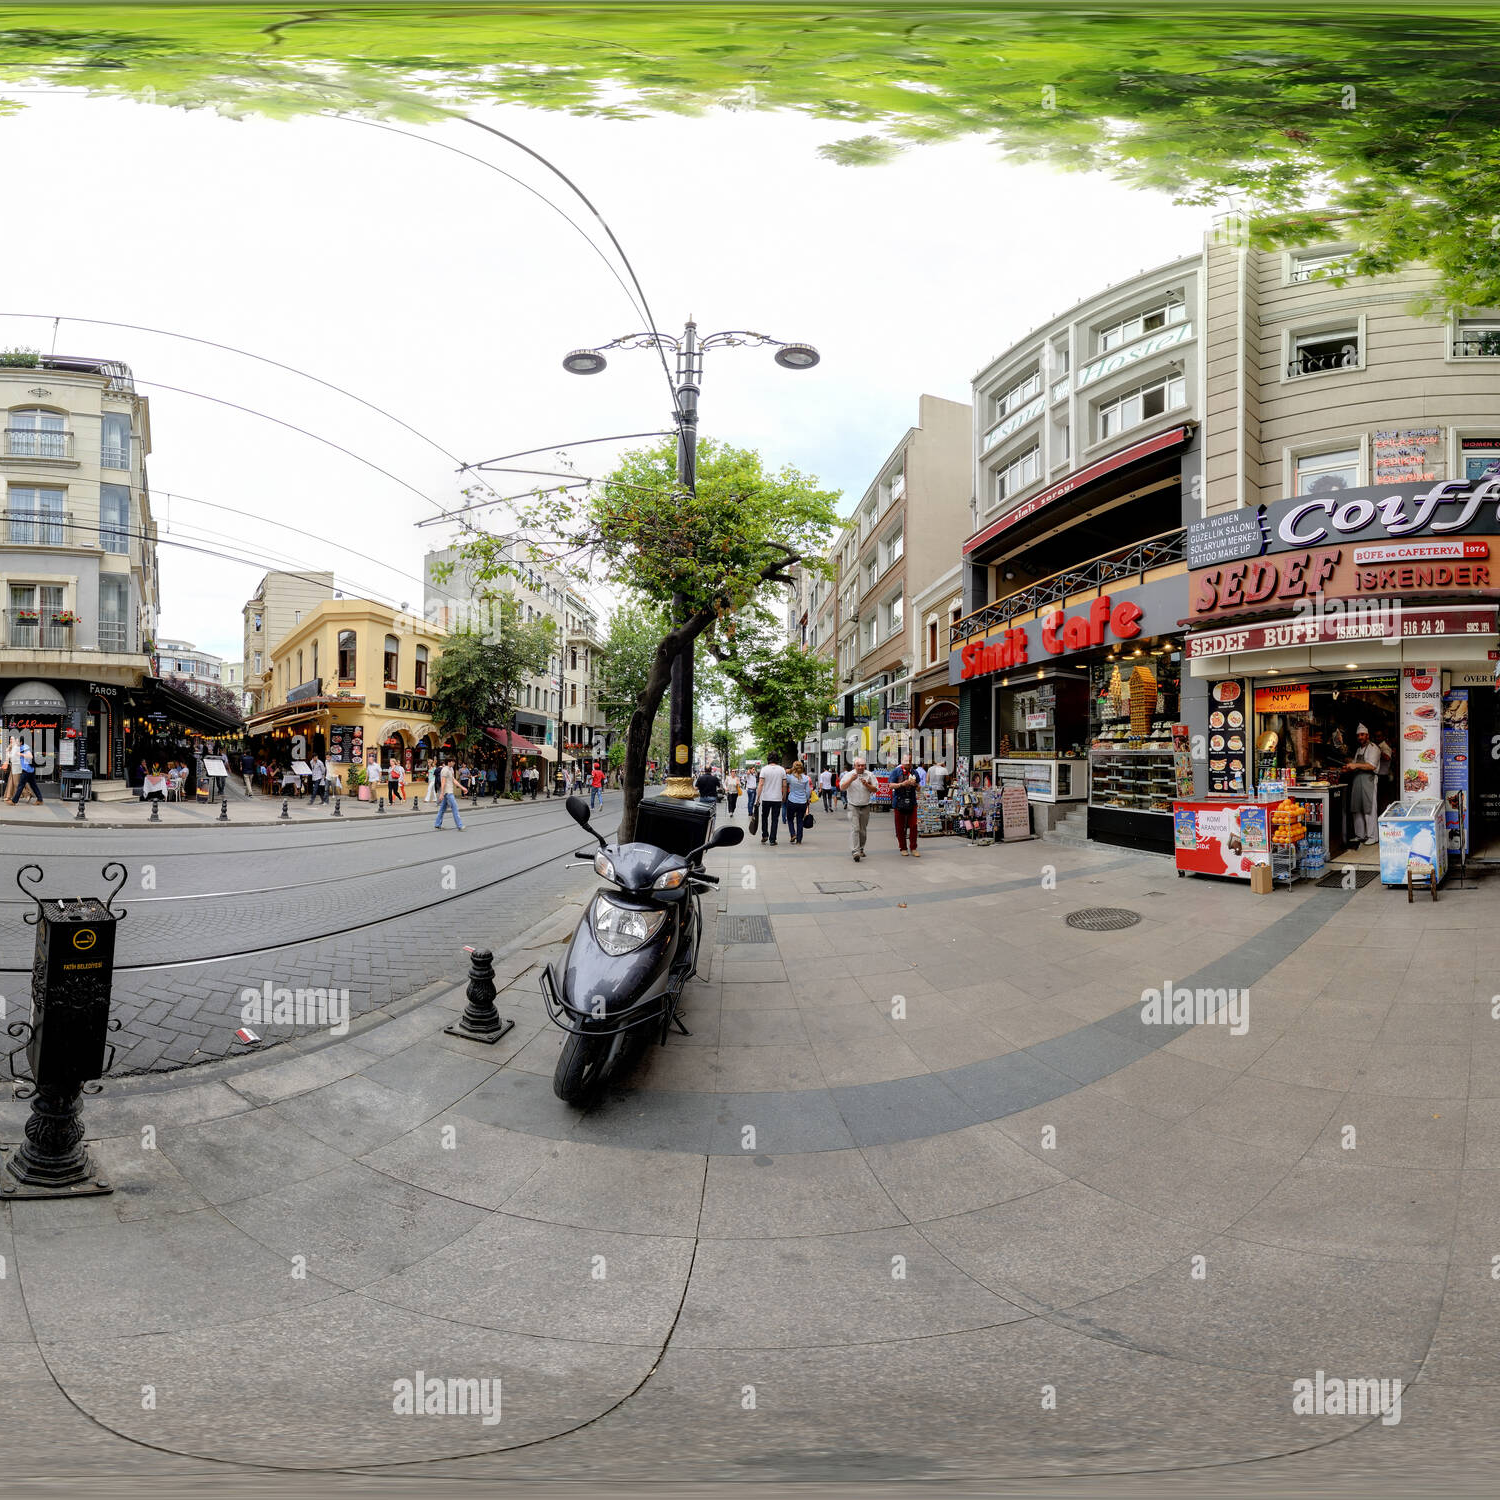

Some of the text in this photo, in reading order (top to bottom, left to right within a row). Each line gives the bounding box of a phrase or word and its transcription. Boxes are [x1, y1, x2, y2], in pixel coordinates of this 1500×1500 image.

[1080, 323, 1190, 386] Hostel
[1013, 481, 1075, 521] simit sarayı
[1190, 513, 1239, 533] MEN WOMEN
[1225, 520, 1257, 536] SALONU
[1190, 538, 1227, 555] SOLARYUM
[1190, 543, 1251, 565] TATTOO MAKE UP
[1356, 549, 1384, 561] BÜFE
[1398, 546, 1461, 558] CAFETERYA
[1465, 545, 1486, 554] 1974
[1196, 549, 1342, 612] SEDEF
[960, 595, 1143, 680] Simit Cafe
[1190, 632, 1250, 657] SEDEF
[1263, 623, 1320, 647] BÜFE
[1403, 620, 1417, 635] 516
[1421, 620, 1431, 634] 24
[1435, 619, 1445, 634] 20
[89, 682, 118, 696] FAROS
[1272, 694, 1292, 702] NTV
[1404, 691, 1440, 699] SEDEF DÖNER
